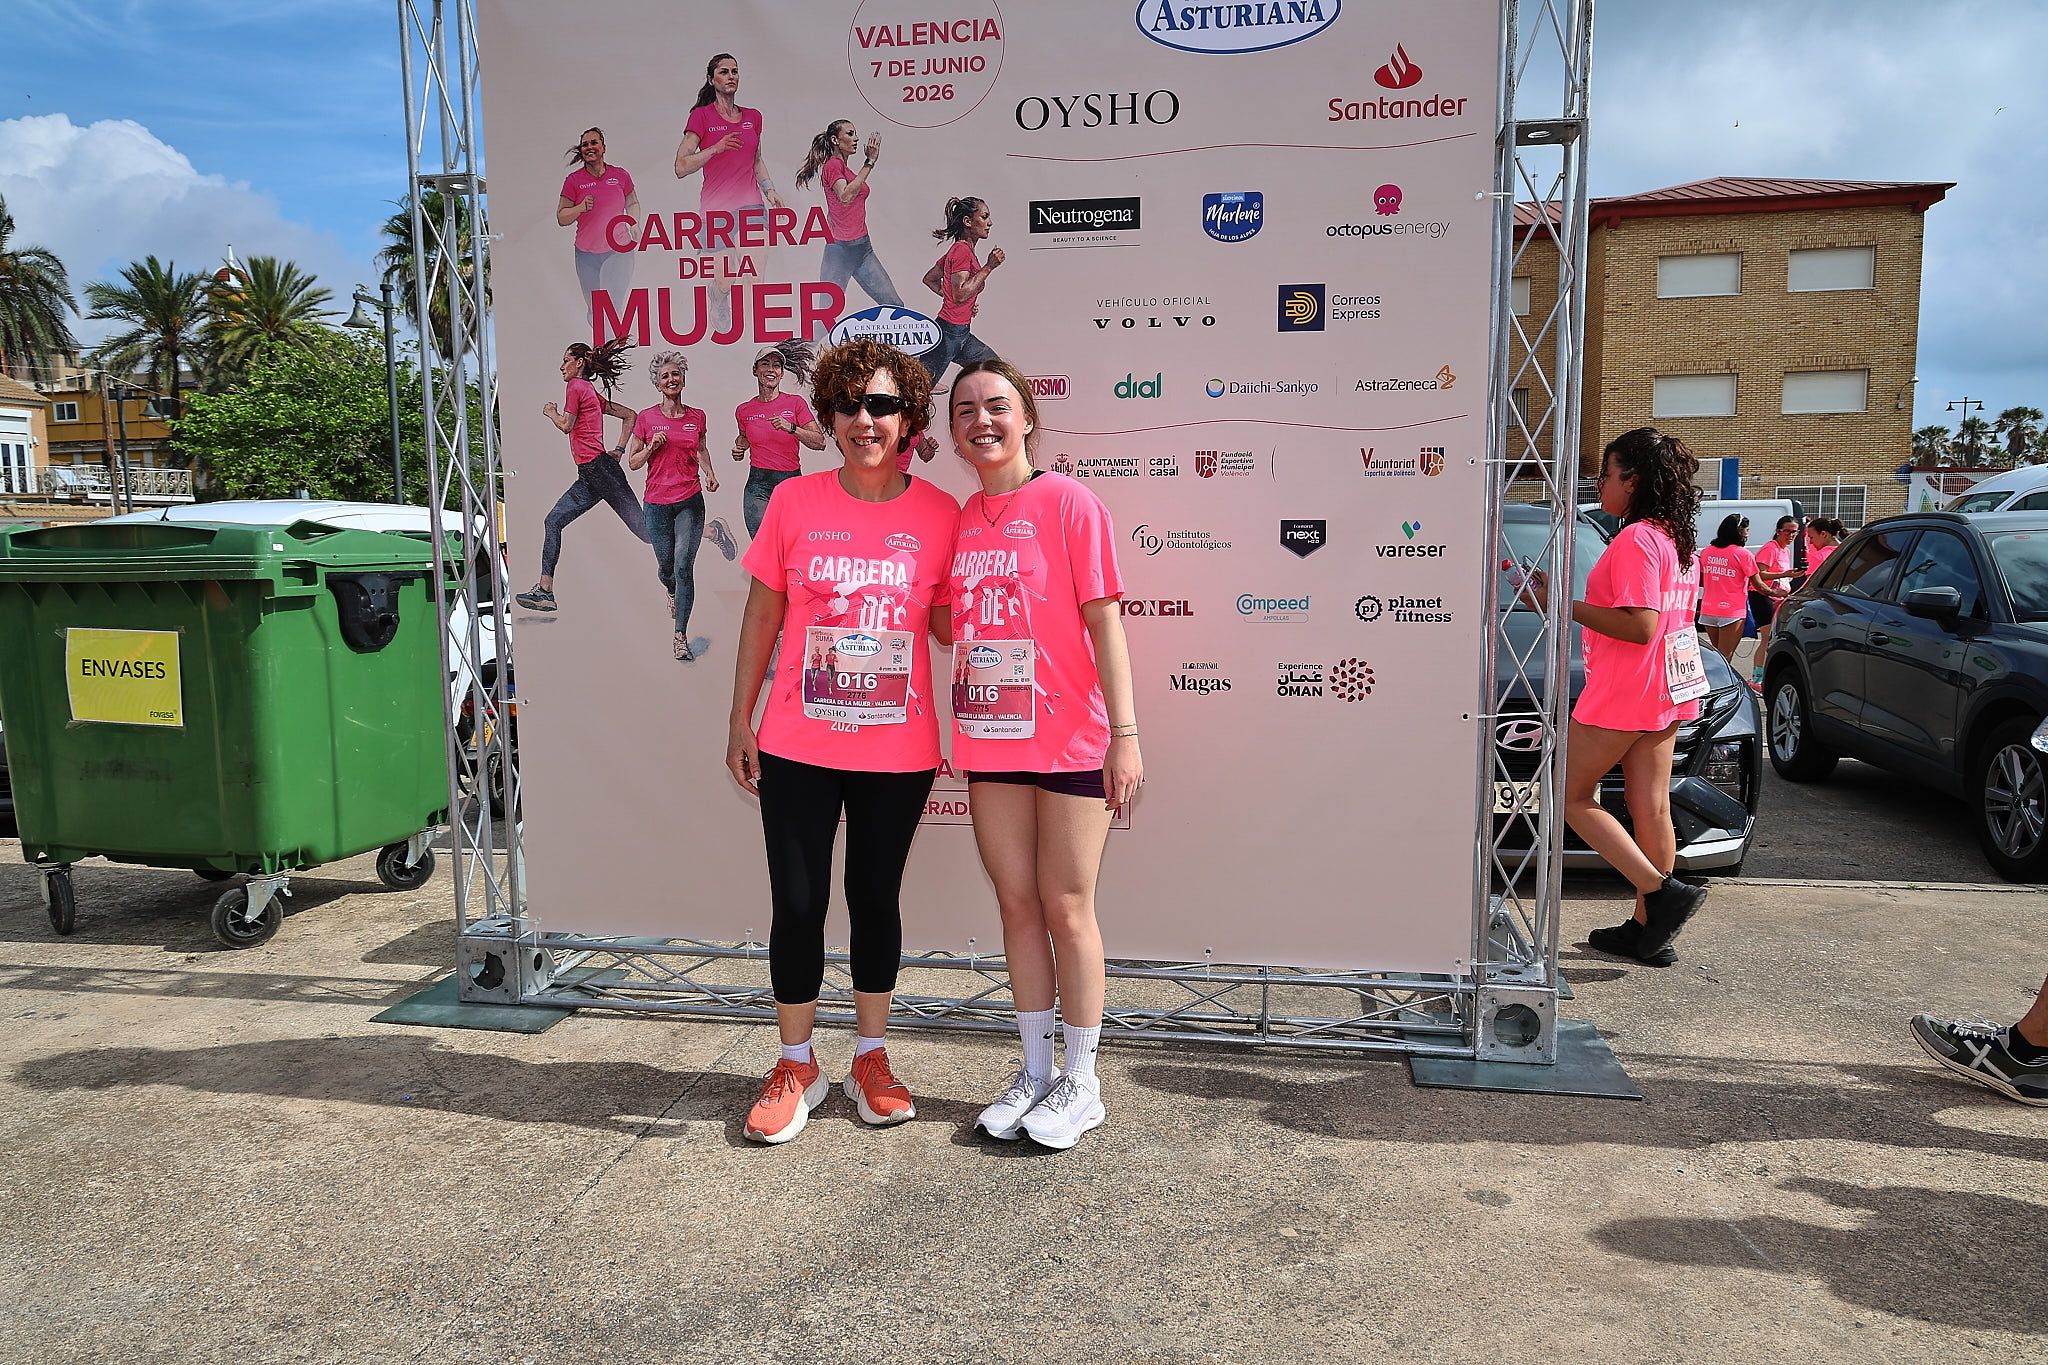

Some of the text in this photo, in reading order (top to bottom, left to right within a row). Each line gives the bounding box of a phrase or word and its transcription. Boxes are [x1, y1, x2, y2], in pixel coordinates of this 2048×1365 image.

[1151, 0, 1326, 32] ASTURIANA
[855, 18, 1001, 48] VALENCIA
[870, 55, 986, 78] 7 DE JUNIO
[902, 84, 955, 102] 2026
[1015, 90, 1180, 131] OYSHO
[1328, 94, 1468, 122] Santander
[1037, 207, 1133, 228] Neutrogena
[1206, 203, 1260, 230] Marlene
[605, 206, 836, 253] CARRERA
[1326, 221, 1450, 239] octopus energy
[679, 255, 757, 280] DE LA
[1096, 296, 1212, 307] VEHÍCULO OFICIAL
[1332, 294, 1381, 306] Correos
[591, 281, 846, 349] MUJER
[1093, 315, 1216, 329] VOLVO
[1332, 308, 1381, 322] Express
[1113, 372, 1162, 399] dial
[1229, 380, 1319, 397] Daiichi-Sankyo
[1355, 378, 1438, 392] AstraZeneca
[1077, 458, 1140, 467] AJUNTAMENT
[1149, 457, 1171, 469] cap
[1360, 448, 1416, 469] Voluntariat
[1077, 467, 1140, 478] DE VALÈNCIA
[1149, 466, 1179, 477] casal
[808, 531, 851, 542] OYSHO
[1167, 530, 1211, 539] Institutos
[1286, 530, 1320, 540] next
[1166, 539, 1232, 550] Odontológicos
[1375, 545, 1446, 557] vareser
[1237, 593, 1310, 615] Compeed
[1387, 596, 1443, 612] planet
[1394, 609, 1452, 622] fitness
[840, 641, 879, 652] ASTURIANA
[82, 658, 166, 679] ENVASES
[1278, 662, 1323, 670] Experience
[1679, 660, 1696, 675] 016
[836, 672, 878, 690] 016
[1169, 674, 1232, 695] Magas
[968, 685, 999, 702] 016
[1277, 685, 1323, 697] OMAN
[814, 707, 847, 718] OYSHO
[1493, 786, 1533, 809] 92
